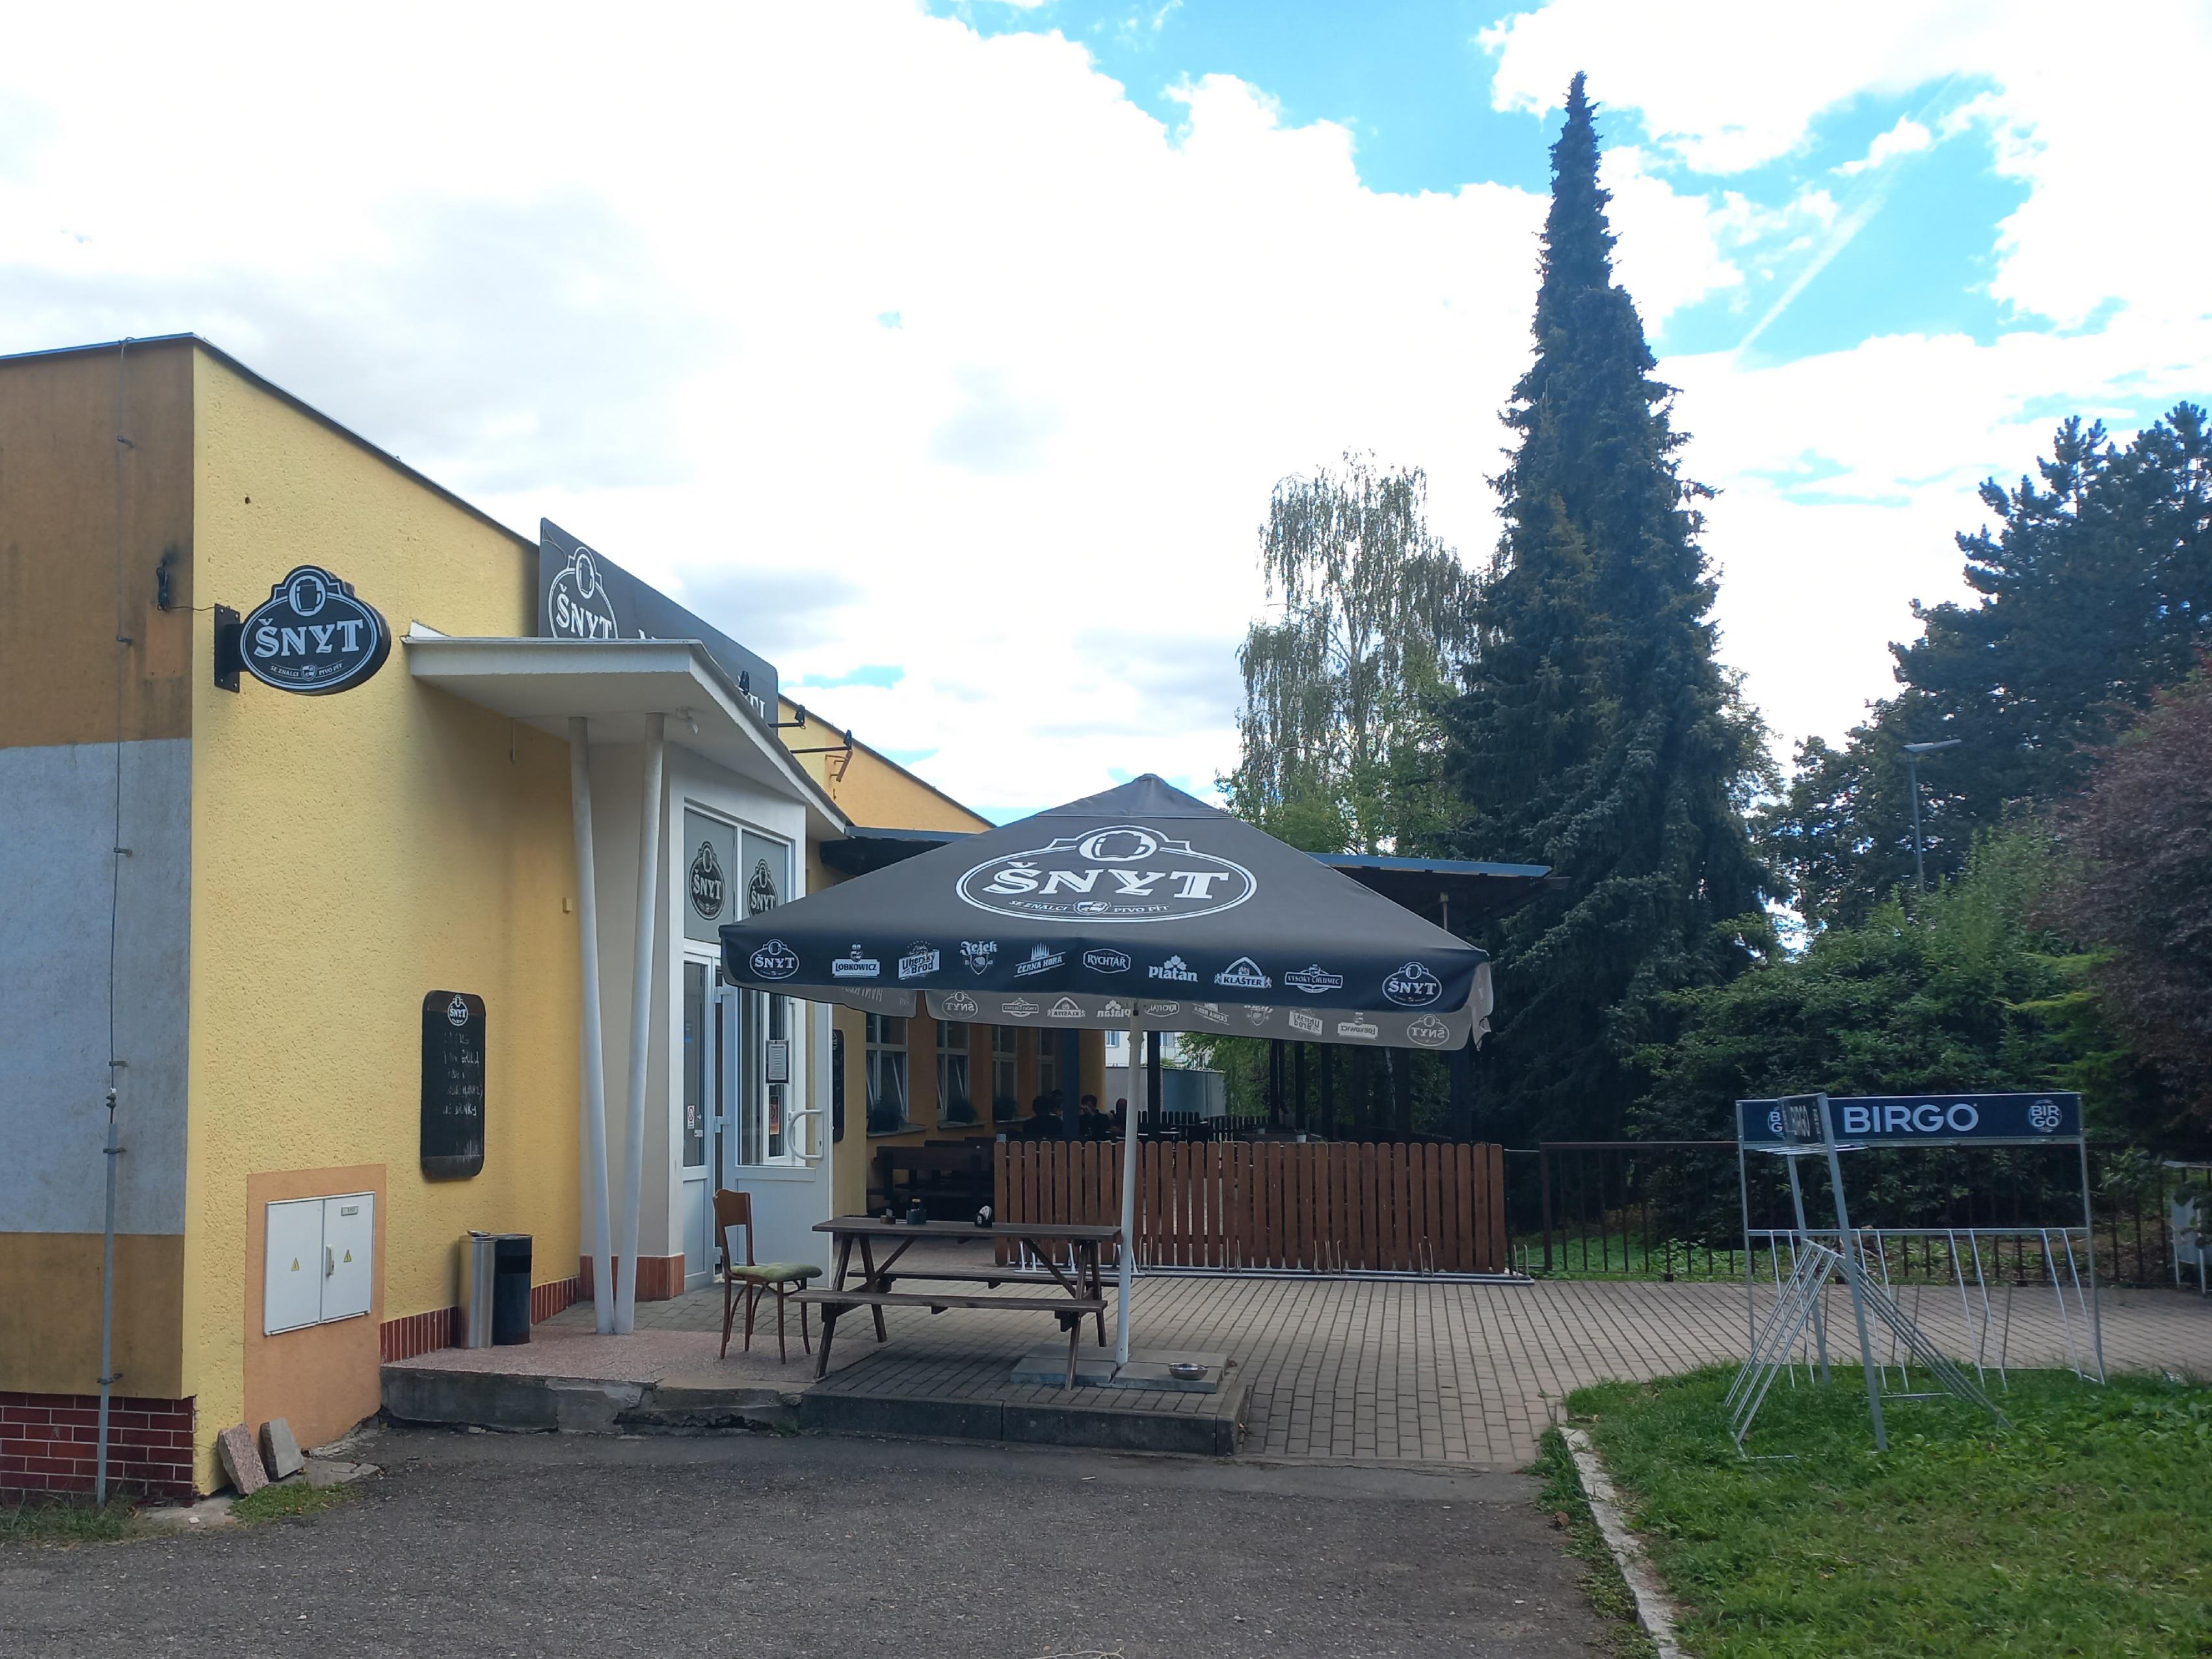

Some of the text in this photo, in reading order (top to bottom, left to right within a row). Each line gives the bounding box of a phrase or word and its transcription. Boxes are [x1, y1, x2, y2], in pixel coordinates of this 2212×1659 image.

[556, 583, 612, 639] ŠNYT
[254, 618, 364, 657] ŠNYT
[693, 868, 721, 899] ŠNYT
[982, 861, 1229, 899] ŠNYT
[751, 886, 775, 910] ŠNYT
[1024, 902, 1067, 912] ZNALCI
[754, 955, 795, 969] ŠNYT
[836, 962, 877, 972] LOBKOWICZ
[1043, 955, 1063, 968] HORA
[1087, 953, 1127, 968] RYCHTÁŘ
[1149, 966, 1198, 982] Platan
[1388, 978, 1436, 995] ŠNYT
[450, 1006, 466, 1018] ŠNYT
[1844, 1103, 1979, 1133] BIRGO
[2030, 1105, 2060, 1116] BIR
[2032, 1116, 2059, 1127] GO
